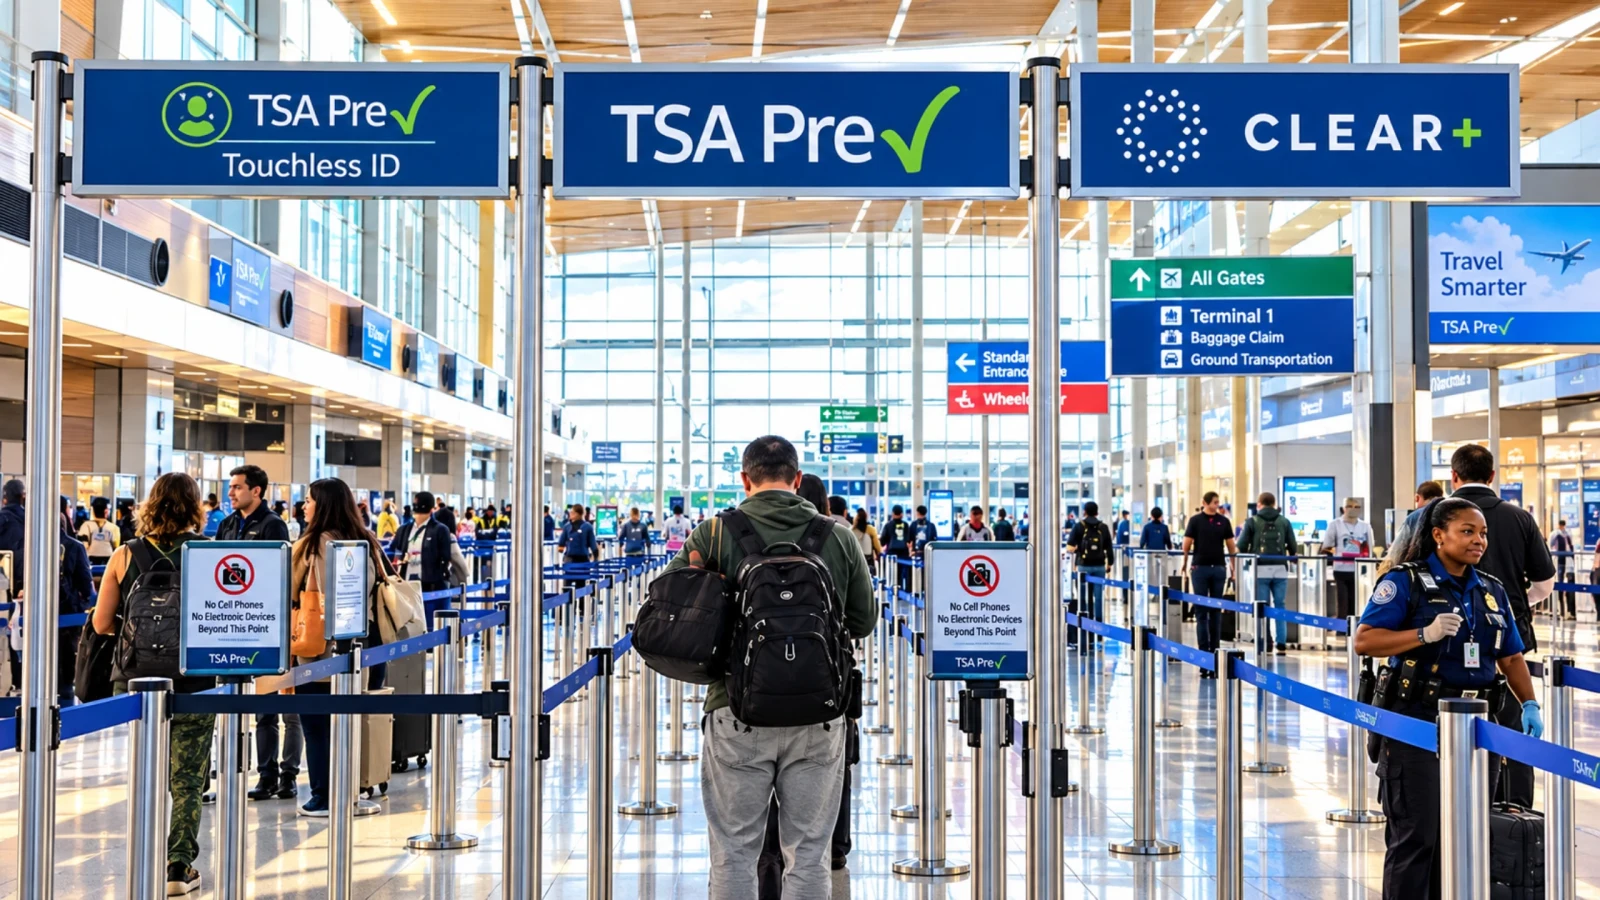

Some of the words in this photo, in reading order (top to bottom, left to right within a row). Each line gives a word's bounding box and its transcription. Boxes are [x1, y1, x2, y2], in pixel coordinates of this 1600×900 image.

[248, 94, 319, 127] TSA
[329, 94, 387, 127] Pre
[610, 103, 745, 164] TSA
[763, 104, 875, 164] Pre
[222, 152, 362, 178] Touchless
[371, 153, 401, 178] ID
[1440, 250, 1504, 271] Travel
[1190, 269, 1213, 286] All
[1216, 269, 1265, 286] Gates
[1441, 277, 1527, 296] Smarter
[1190, 307, 1261, 324] Terminal
[1266, 308, 1274, 323] 1
[1441, 320, 1470, 334] TSA
[1474, 320, 1498, 334] Pre
[1190, 331, 1246, 347] Baggage
[1249, 330, 1285, 344] Claim
[983, 351, 1030, 363] Standar
[1190, 352, 1238, 366] Ground
[1241, 351, 1333, 369] Transportation
[983, 365, 1029, 378] Entranc
[204, 600, 216, 609] No
[218, 600, 233, 609] Cell
[234, 600, 264, 609] Phones
[949, 602, 962, 611] No
[963, 602, 978, 611] Cell
[980, 602, 1010, 611] Phones
[191, 612, 203, 621] No
[245, 612, 276, 621] Devices
[938, 614, 949, 624] No
[950, 614, 990, 624] Electronic
[991, 614, 1023, 624] Devices
[198, 624, 229, 635] Beyond
[230, 624, 247, 634] This
[248, 624, 269, 634] Point
[943, 626, 975, 638] Beyond
[976, 626, 994, 637] This
[995, 626, 1017, 637] Point
[208, 653, 228, 664] TSA
[230, 653, 247, 664] Pre
[954, 656, 976, 668] TSA
[977, 657, 994, 668] Pre
